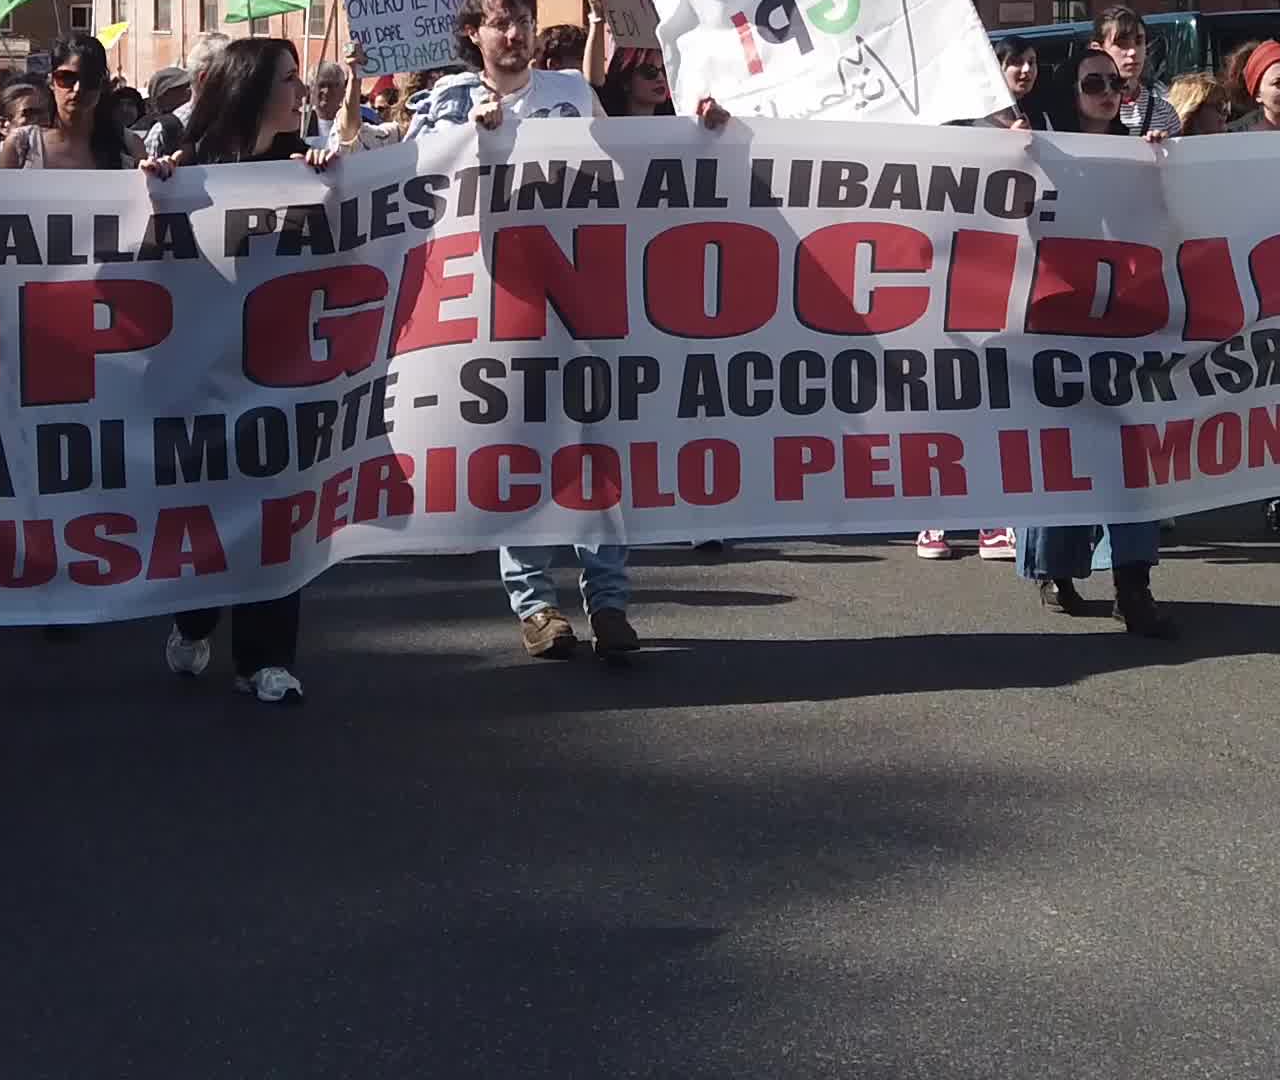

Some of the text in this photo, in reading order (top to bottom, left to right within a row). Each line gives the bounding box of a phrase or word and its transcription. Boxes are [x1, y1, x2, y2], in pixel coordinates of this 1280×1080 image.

[376, 23, 405, 45] DARE
[224, 158, 620, 258] PALESTINA
[636, 158, 729, 209] AL
[749, 158, 1059, 222] LIBANO:
[36, 420, 127, 496] DI
[154, 372, 400, 486] MORTE
[460, 354, 661, 425] STOP
[677, 348, 1011, 419] ACCORDI
[261, 437, 741, 567] PERICOLO
[773, 431, 968, 502] PER
[999, 428, 1093, 496] IL
